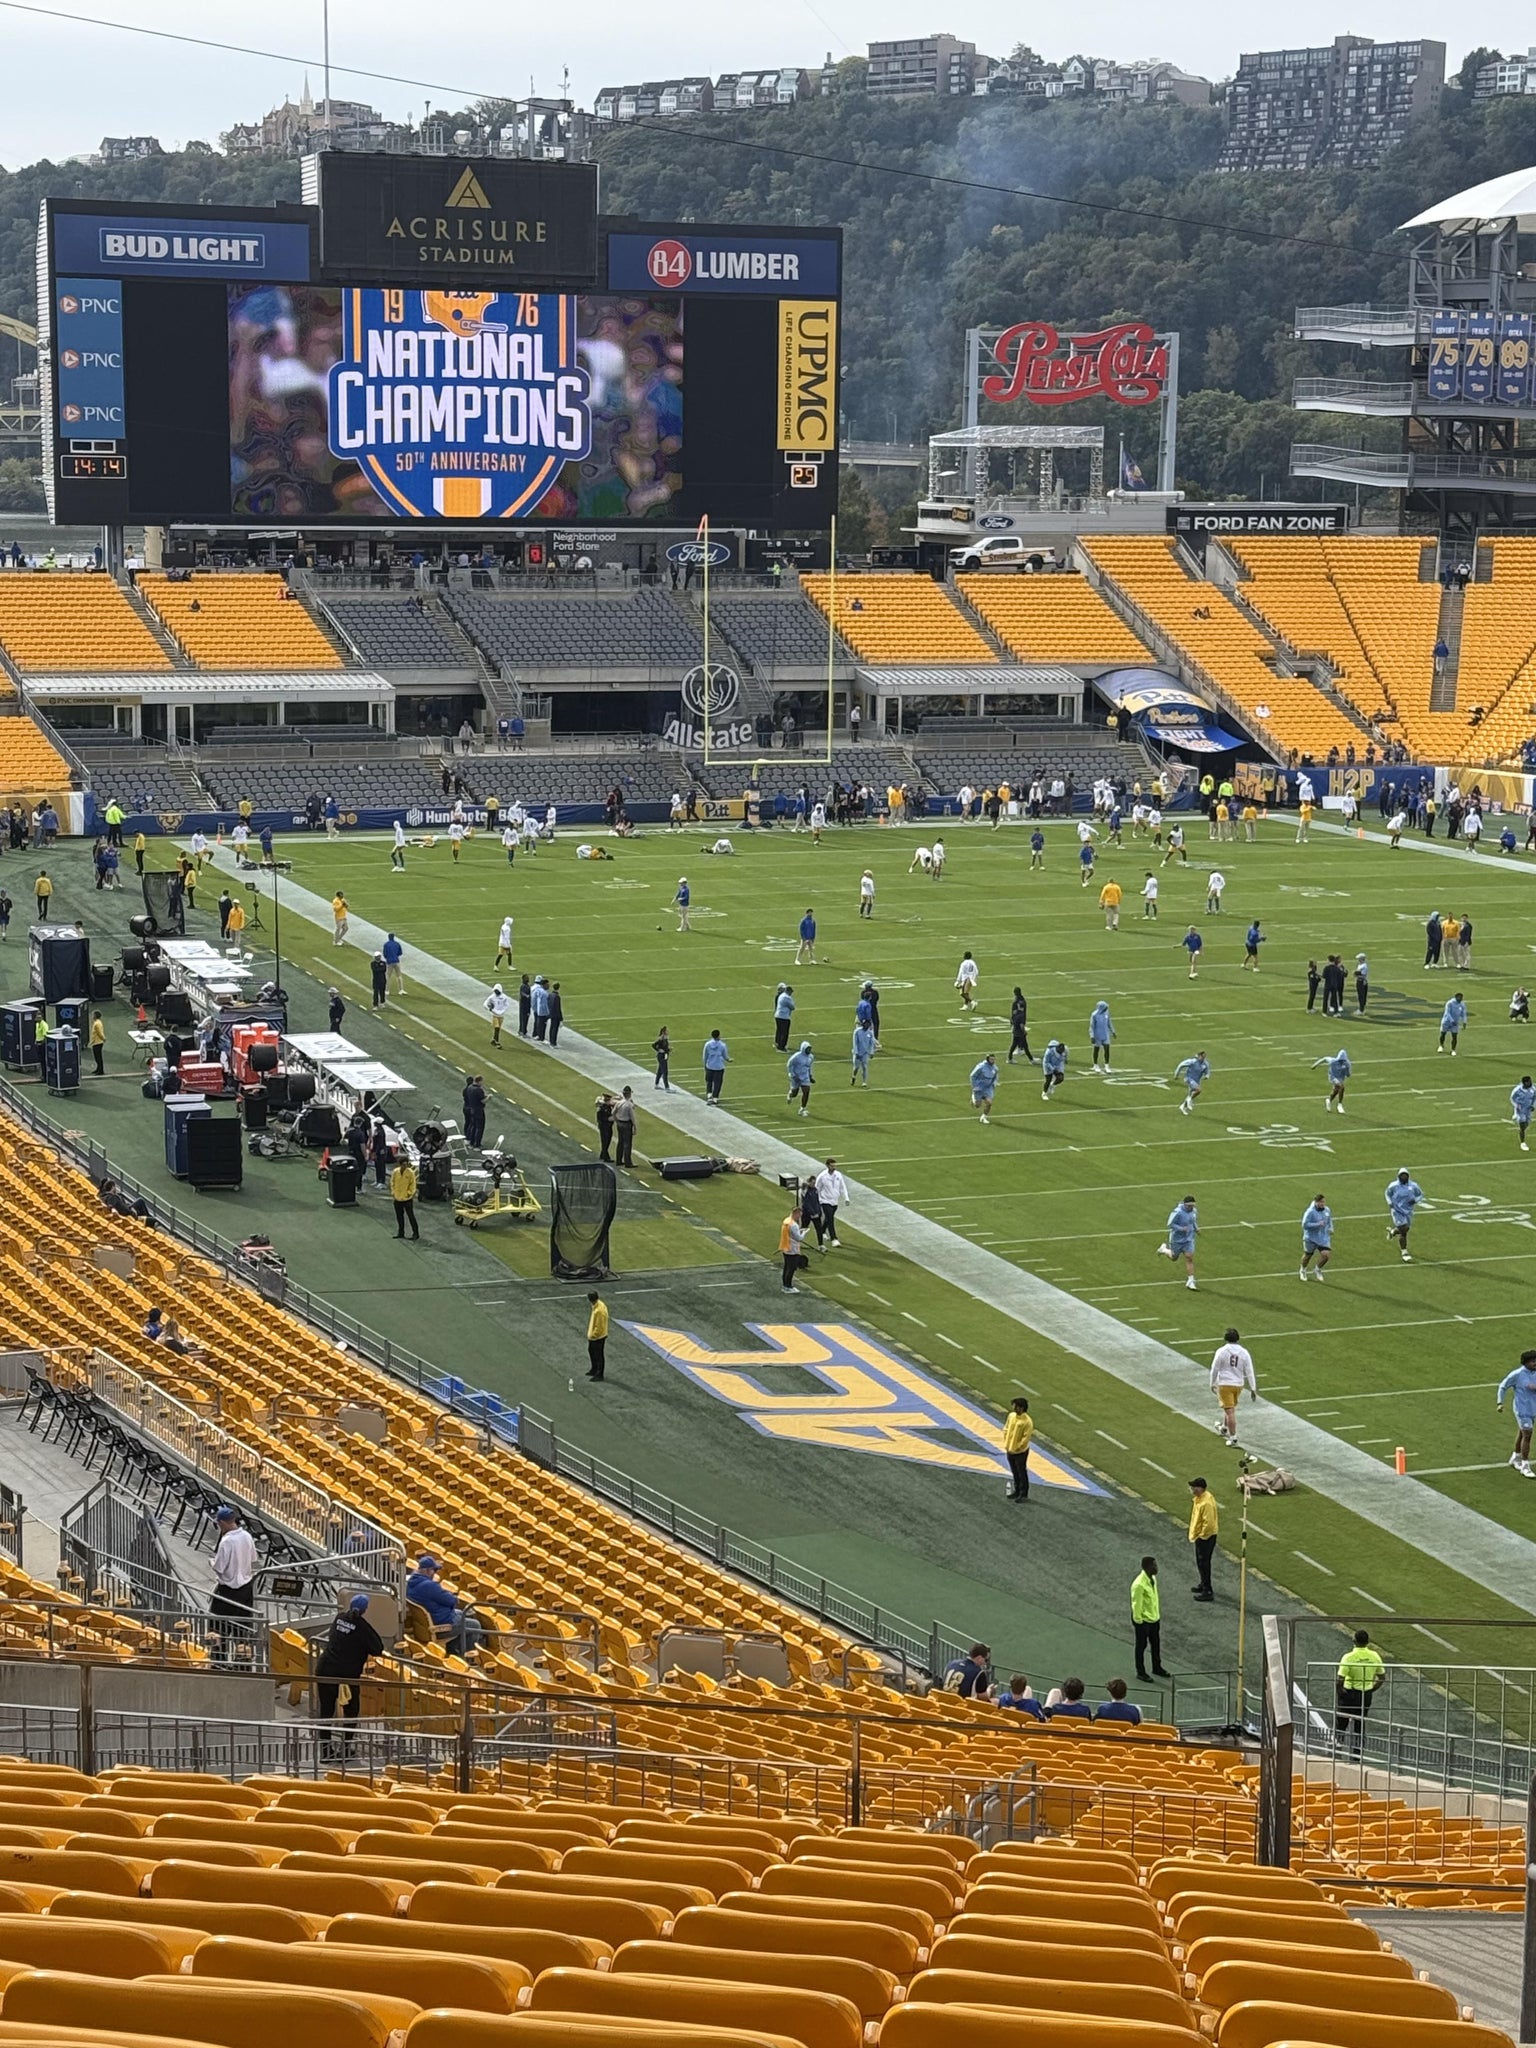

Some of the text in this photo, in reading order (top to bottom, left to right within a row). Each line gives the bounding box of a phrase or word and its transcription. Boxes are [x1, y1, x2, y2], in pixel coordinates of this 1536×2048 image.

[385, 216, 547, 243] ACRISURE
[105, 233, 259, 262] BUD LIGHT
[419, 247, 515, 264] STADIUM
[652, 250, 799, 280] 84 LUMBER
[80, 297, 120, 314] PNC
[381, 289, 404, 323] 19
[513, 293, 539, 327] 76
[82, 352, 121, 368] PNC
[367, 329, 555, 381] NATIONAL
[1431, 338, 1459, 366] 75
[1466, 338, 1494, 367] 79
[1501, 340, 1529, 368] 89
[784, 311, 793, 441] LIFE CHANGING MEDICINE
[796, 308, 829, 441] UPMC
[83, 406, 121, 422] PNC
[338, 371, 582, 450] CHAMPIONS
[73, 459, 121, 475] 14:14
[430, 452, 527, 474] ANNIVERSARY
[984, 517, 1009, 528] Ford
[1194, 517, 1335, 530] FORD FAN ZONE
[553, 532, 617, 543] Neighborhood
[553, 542, 600, 551] Ford Store
[678, 543, 718, 562] Ford
[663, 719, 753, 750] Allstate
[1329, 768, 1375, 798] H2P
[702, 801, 730, 817] Pitt
